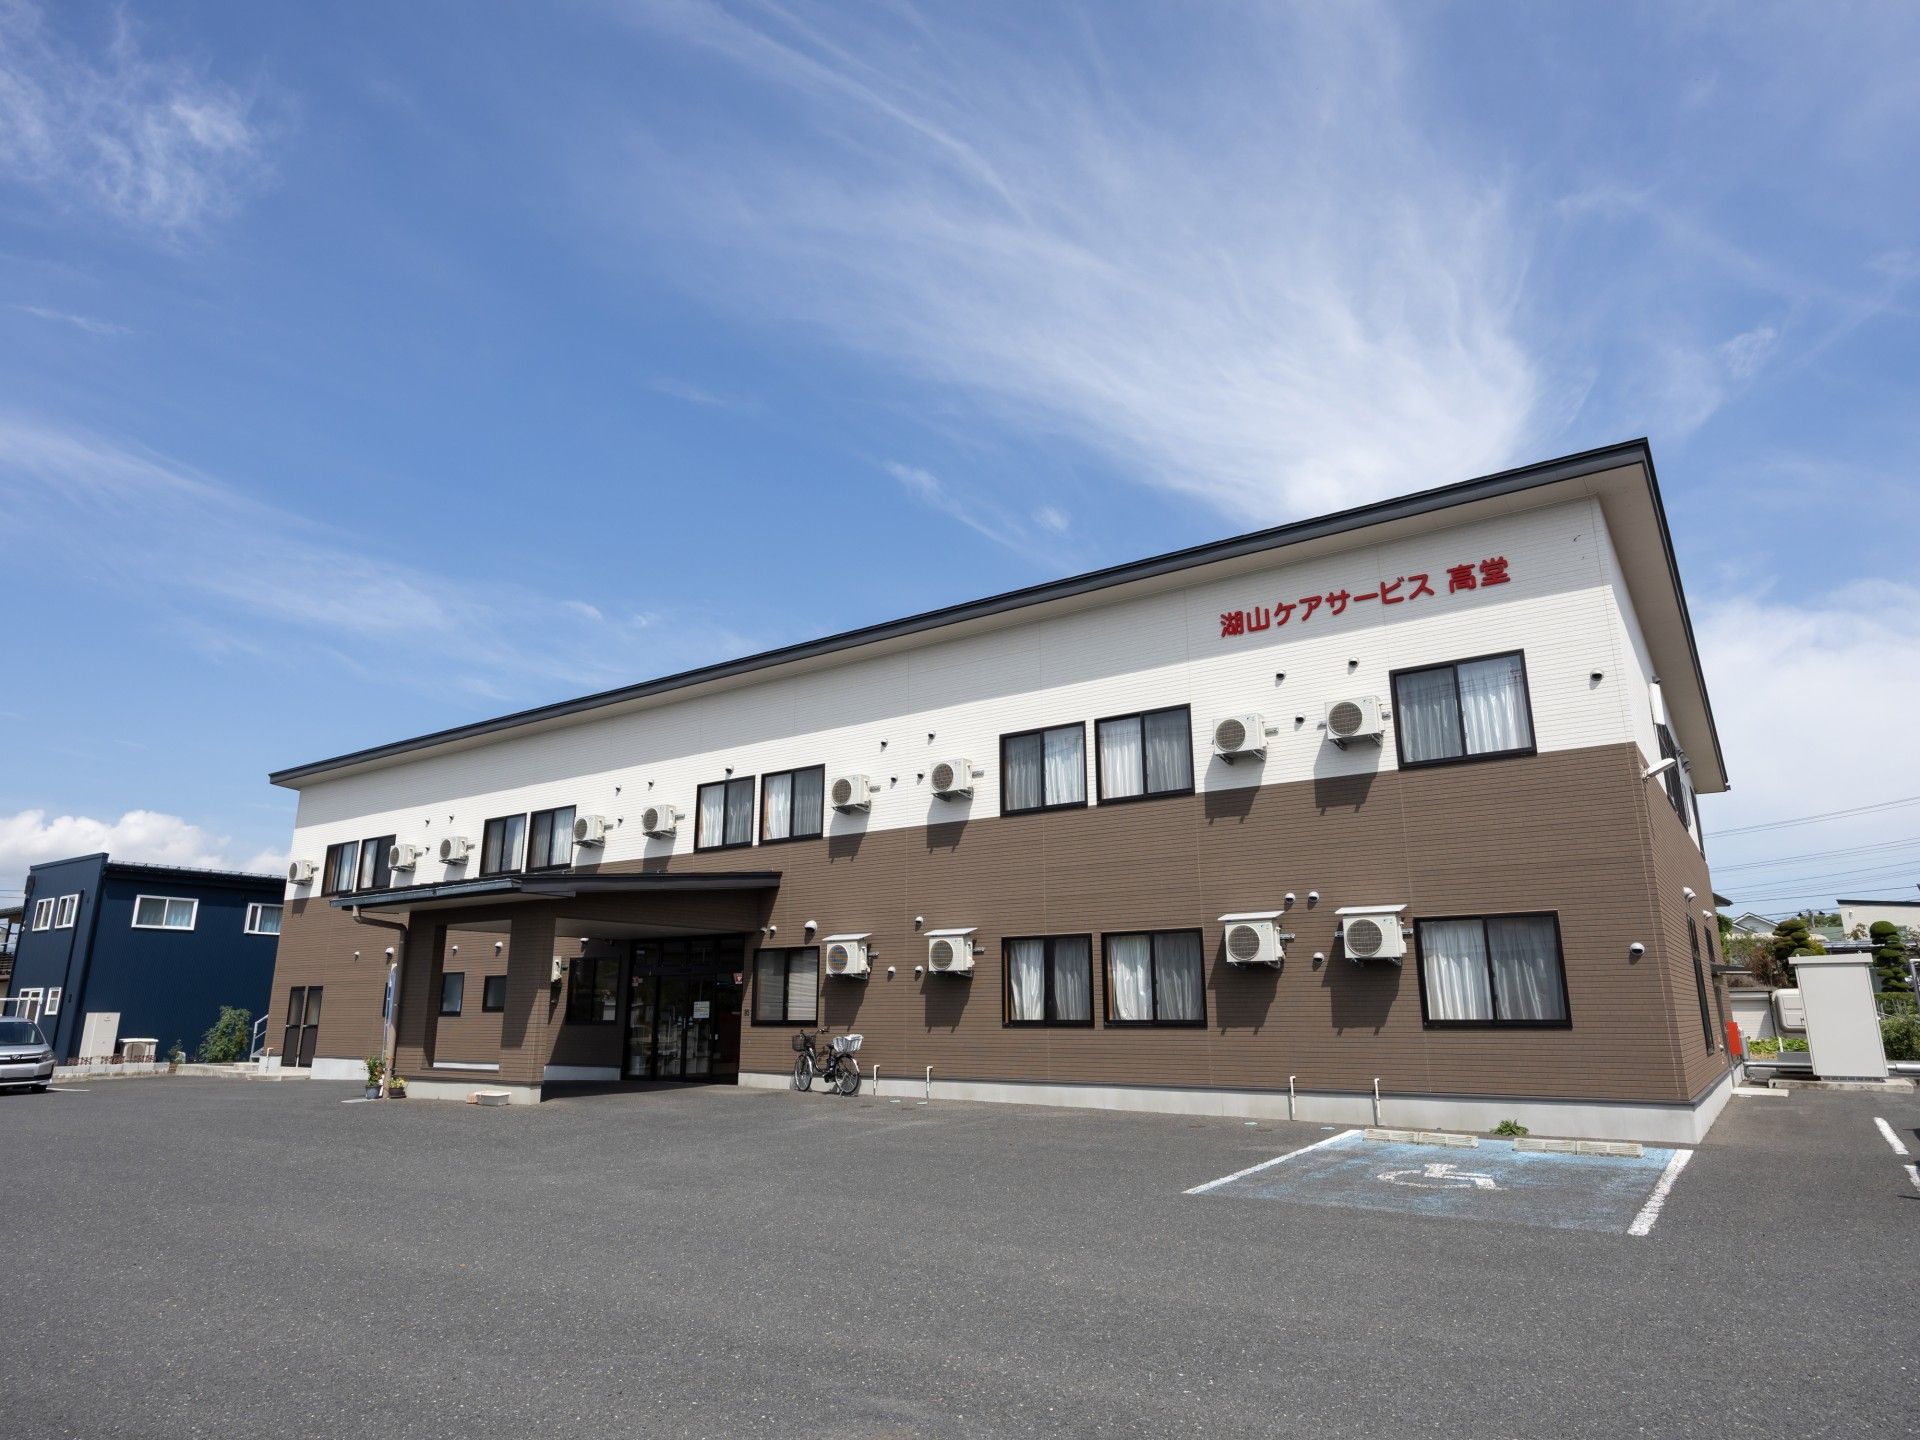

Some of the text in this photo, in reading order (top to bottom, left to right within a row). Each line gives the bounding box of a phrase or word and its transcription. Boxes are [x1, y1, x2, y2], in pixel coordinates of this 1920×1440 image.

[1220, 556, 1510, 637] 湖山ケアサービス 高堂
